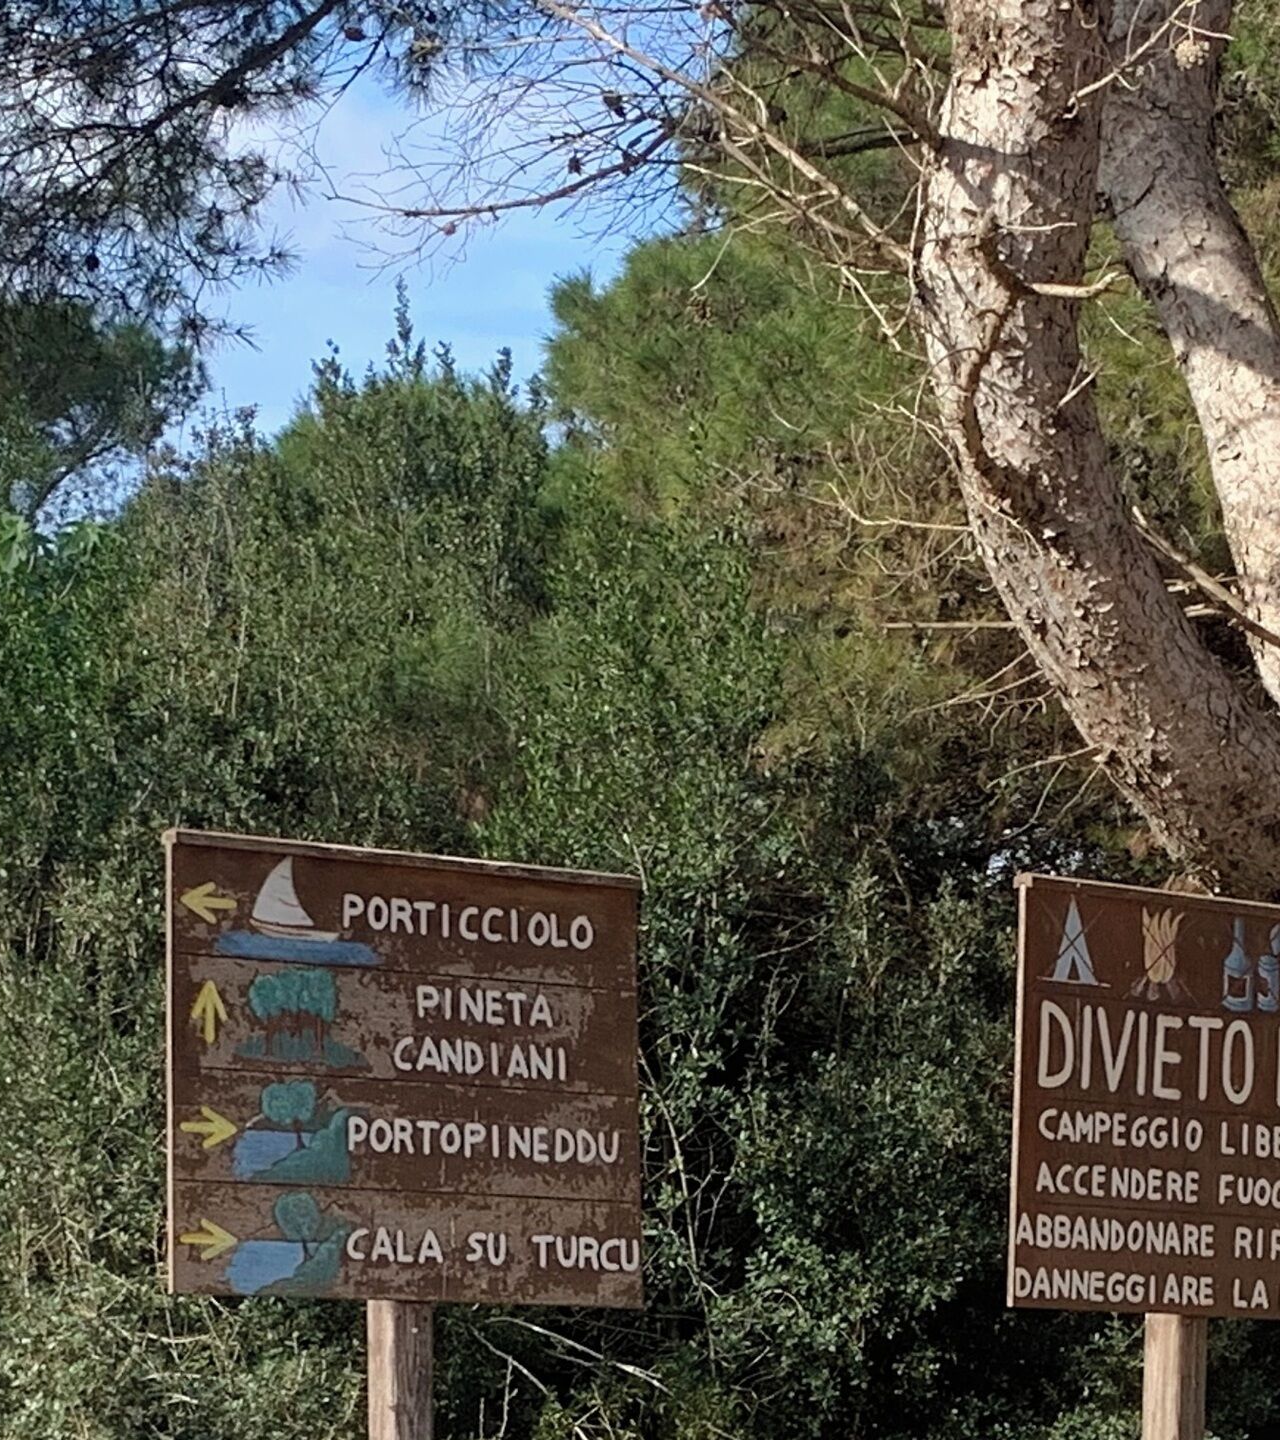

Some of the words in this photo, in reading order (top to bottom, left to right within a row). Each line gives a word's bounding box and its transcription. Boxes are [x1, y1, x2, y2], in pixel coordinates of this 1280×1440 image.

[342, 893, 594, 950] PORTICCIOLO
[416, 984, 554, 1028] PINETA
[393, 1035, 566, 1081] CANDIANI
[1037, 1000, 1254, 1104] DIVIETO
[348, 1115, 619, 1164] PORTOPINEDDU
[1038, 1108, 1203, 1152] CAMPEGGIO
[1036, 1162, 1200, 1203] ACCENDERE
[346, 1226, 444, 1264] CALA
[466, 1231, 508, 1265] SU
[532, 1234, 639, 1272] TURCU
[1016, 1212, 1214, 1258] ABBANDONARE
[1014, 1267, 1214, 1307] DANNEGGIARE
[1233, 1278, 1269, 1309] LA
